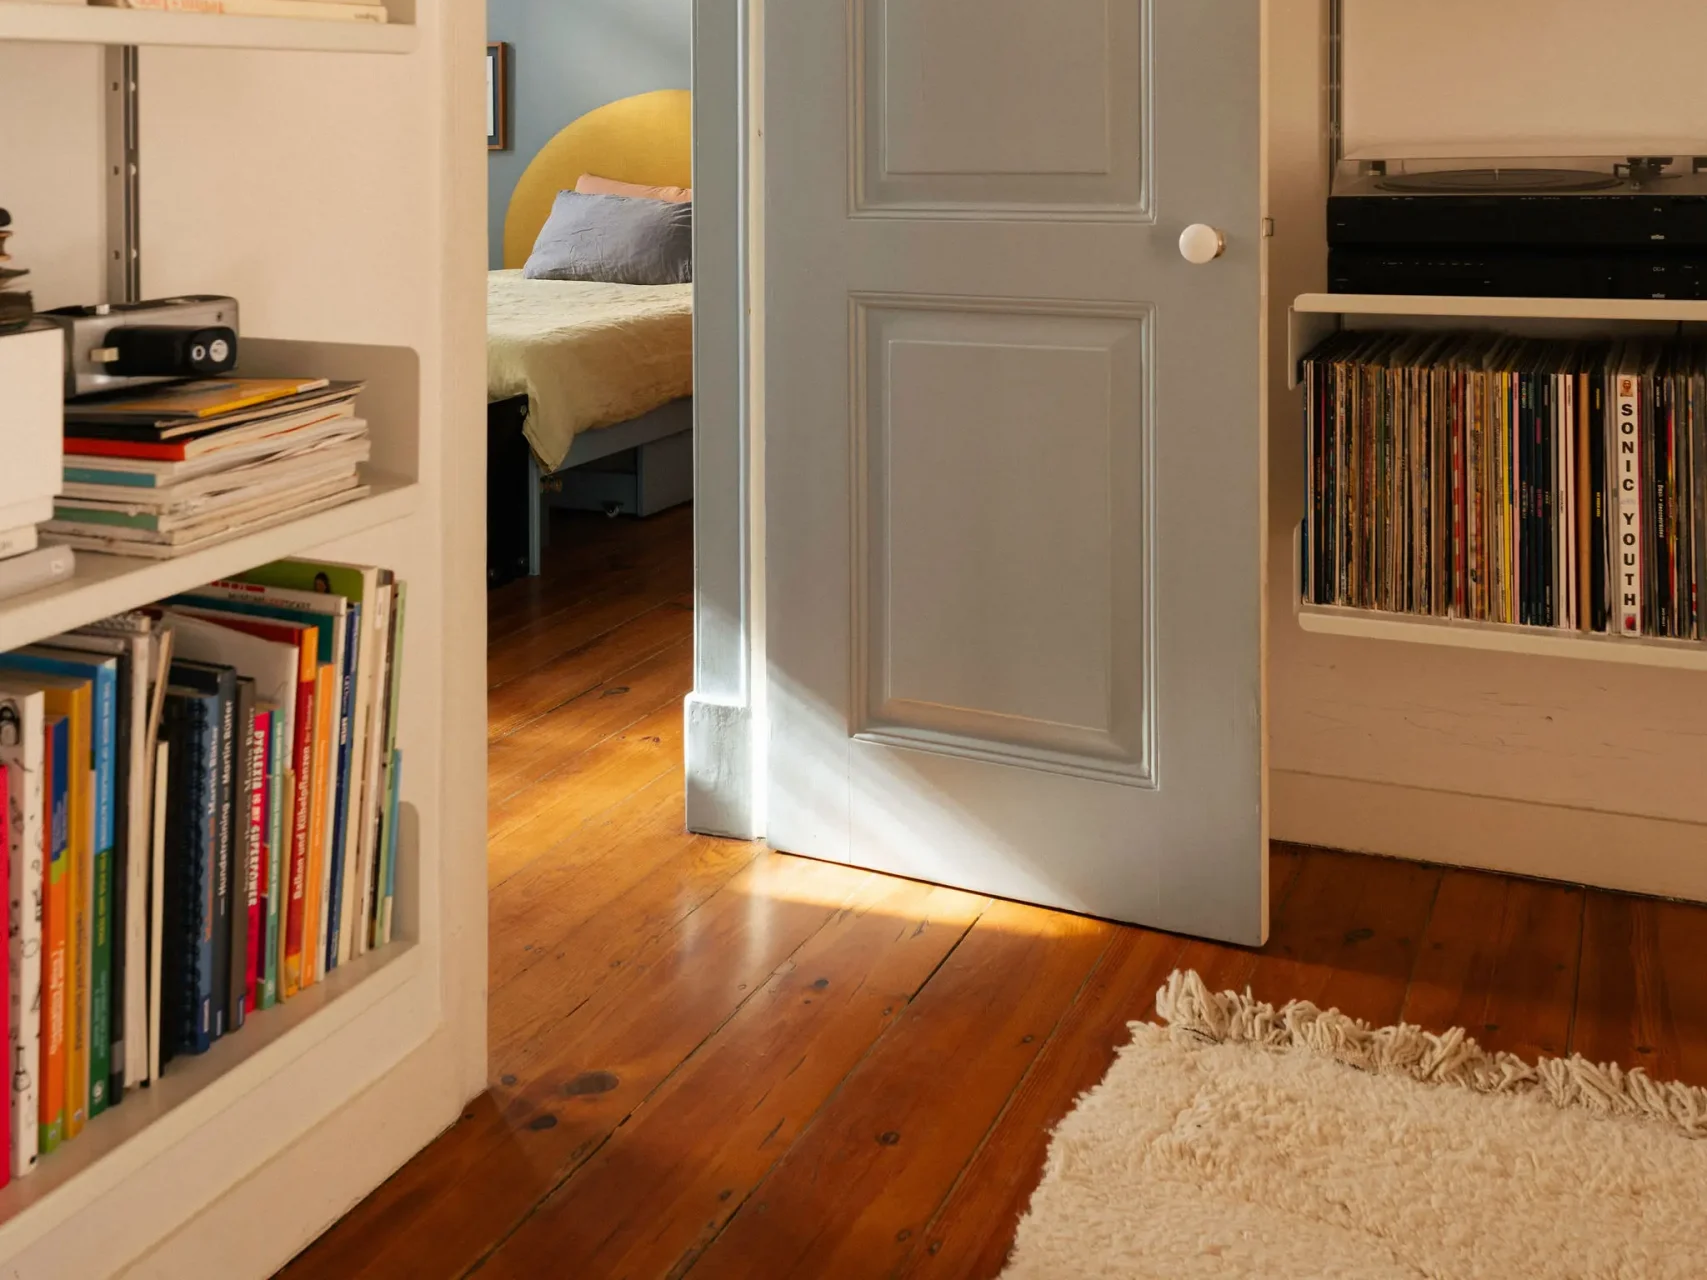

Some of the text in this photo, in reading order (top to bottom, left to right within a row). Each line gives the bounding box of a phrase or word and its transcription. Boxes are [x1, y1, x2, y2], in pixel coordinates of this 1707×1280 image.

[1621, 403, 1636, 606] SONIC YOUTH
[251, 730, 265, 790] DYSLEXIA
[296, 746, 311, 830] Kübelpflanzen
[208, 770, 217, 815] Martin
[218, 700, 233, 896] Hundetraining Martin Rütter
[251, 793, 262, 804] IS
[248, 824, 260, 906] SUPERPOWER
[296, 833, 306, 856] und
[292, 858, 304, 899] Balkon
